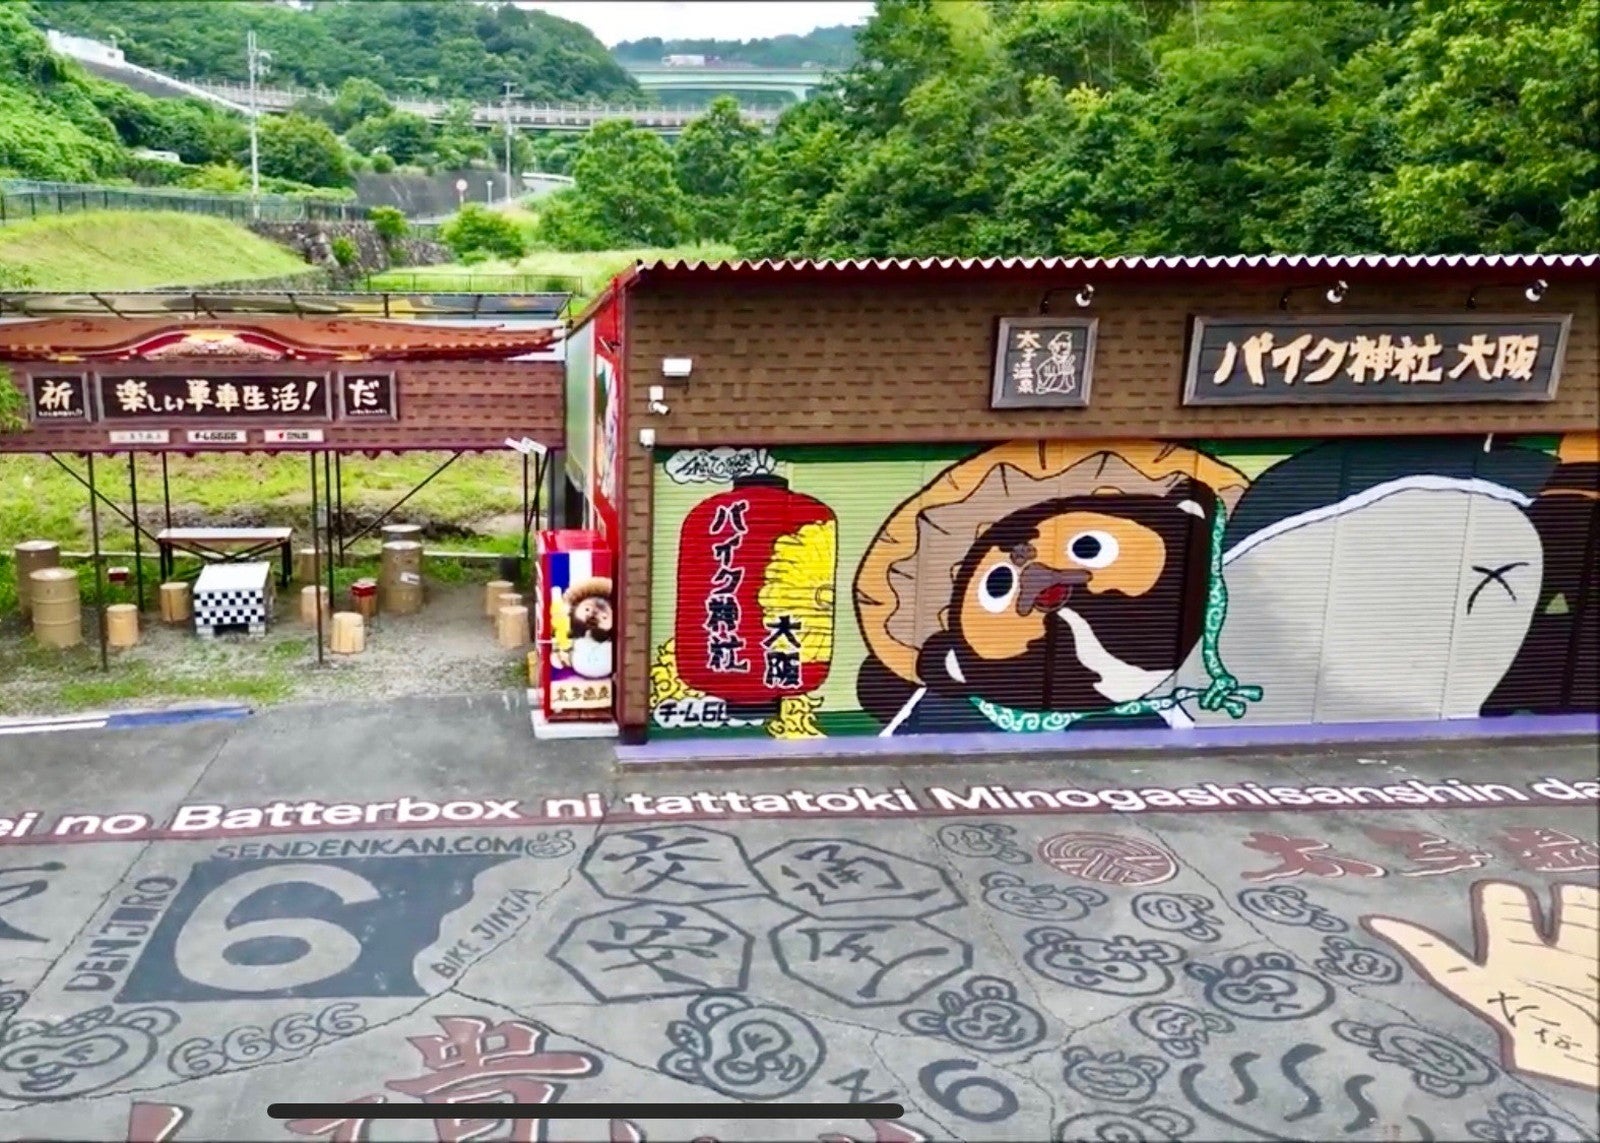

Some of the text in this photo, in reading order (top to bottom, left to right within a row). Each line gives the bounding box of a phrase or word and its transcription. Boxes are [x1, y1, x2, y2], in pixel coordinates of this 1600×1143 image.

[1212, 331, 1540, 386] バイク神社 大阪
[38, 380, 74, 410] 祈
[348, 379, 380, 409] だ
[705, 500, 750, 673] バイク神社
[760, 613, 803, 688] 大阪
[54, 813, 147, 835] no
[171, 798, 519, 832] Batterbox
[546, 791, 602, 818] ni
[623, 786, 919, 815] tattatoki
[930, 778, 1529, 812] Minogashisanshin
[210, 835, 523, 861] SENDENKAN.COM
[62, 876, 178, 992] DENJIRO
[174, 863, 382, 992] 6
[430, 888, 543, 980] BIKE JINJA
[168, 1002, 368, 1079] 6666
[918, 1058, 1020, 1123] 6
